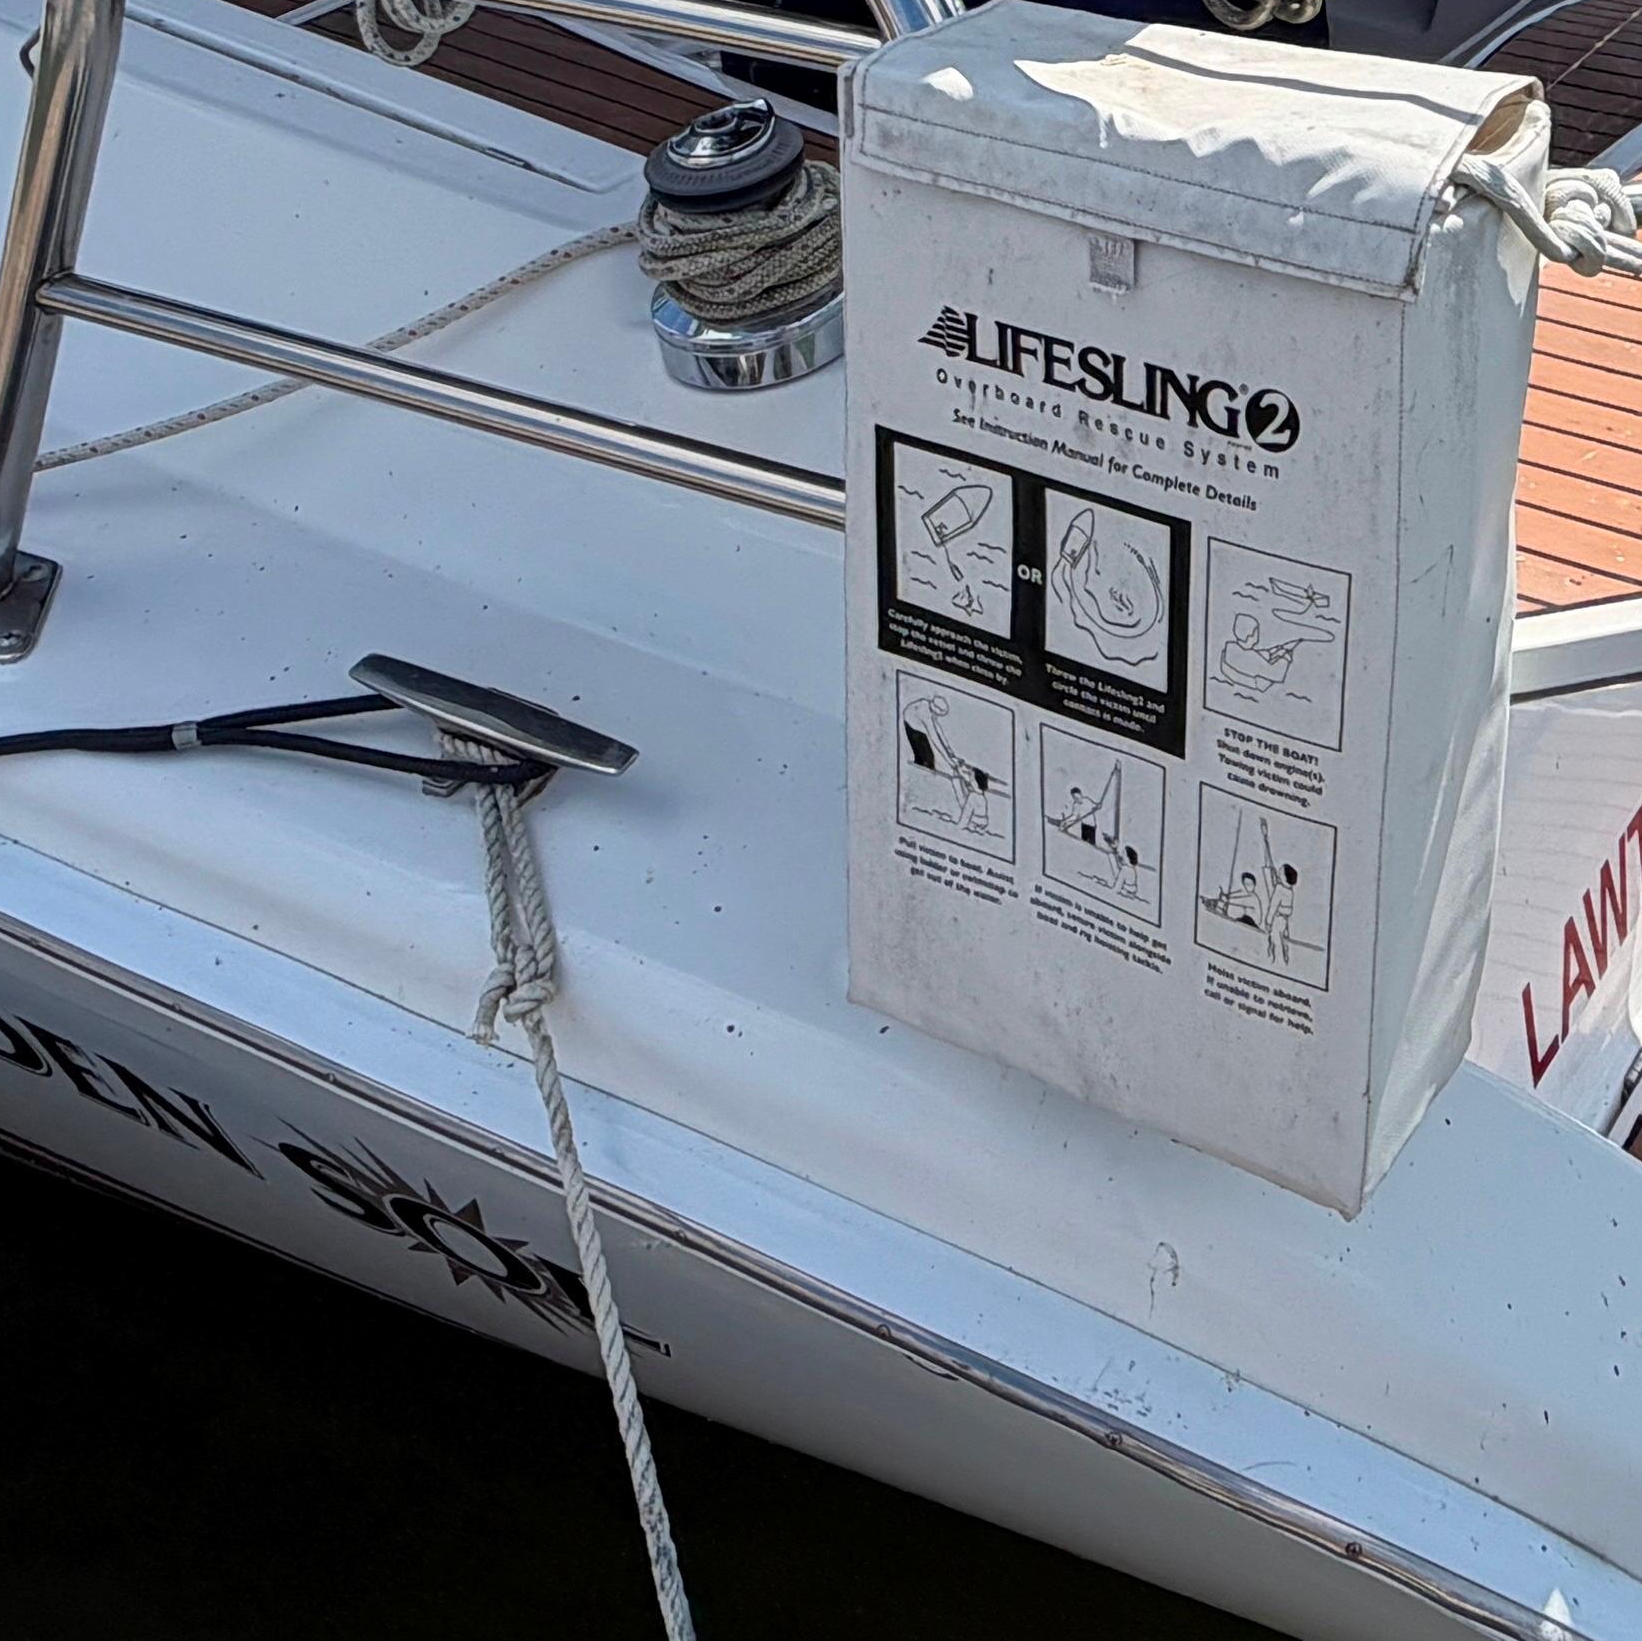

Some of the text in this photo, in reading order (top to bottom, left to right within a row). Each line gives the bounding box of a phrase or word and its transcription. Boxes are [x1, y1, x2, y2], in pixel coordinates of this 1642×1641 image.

[964, 312, 1241, 439] LIFESLING
[936, 368, 1280, 480] Overboard Rescue System
[952, 408, 1258, 512] See Instruction Manual for Complete Details
[1017, 564, 1043, 586] OR
[887, 607, 929, 632] Carefully
[973, 639, 989, 652] the
[911, 629, 927, 643] the
[1045, 662, 1077, 682] Throw
[1079, 676, 1096, 690] the
[1146, 699, 1166, 714] and
[1051, 680, 1079, 696] circle
[1080, 690, 1098, 703] the
[1132, 709, 1157, 724] until
[1217, 738, 1240, 754] Shut
[1242, 749, 1272, 766] down
[1224, 727, 1319, 766] STOP THE BOAT!
[1217, 751, 1323, 796] Towing victim could
[1226, 771, 1311, 808] cause drowning.
[1206, 974, 1215, 987] If
[1216, 981, 1250, 1000] unable
[1252, 993, 1265, 1005] to
[1207, 961, 1235, 981] Hoist
[1237, 975, 1270, 994] victim
[1203, 988, 1315, 1037] call or signal for help.
